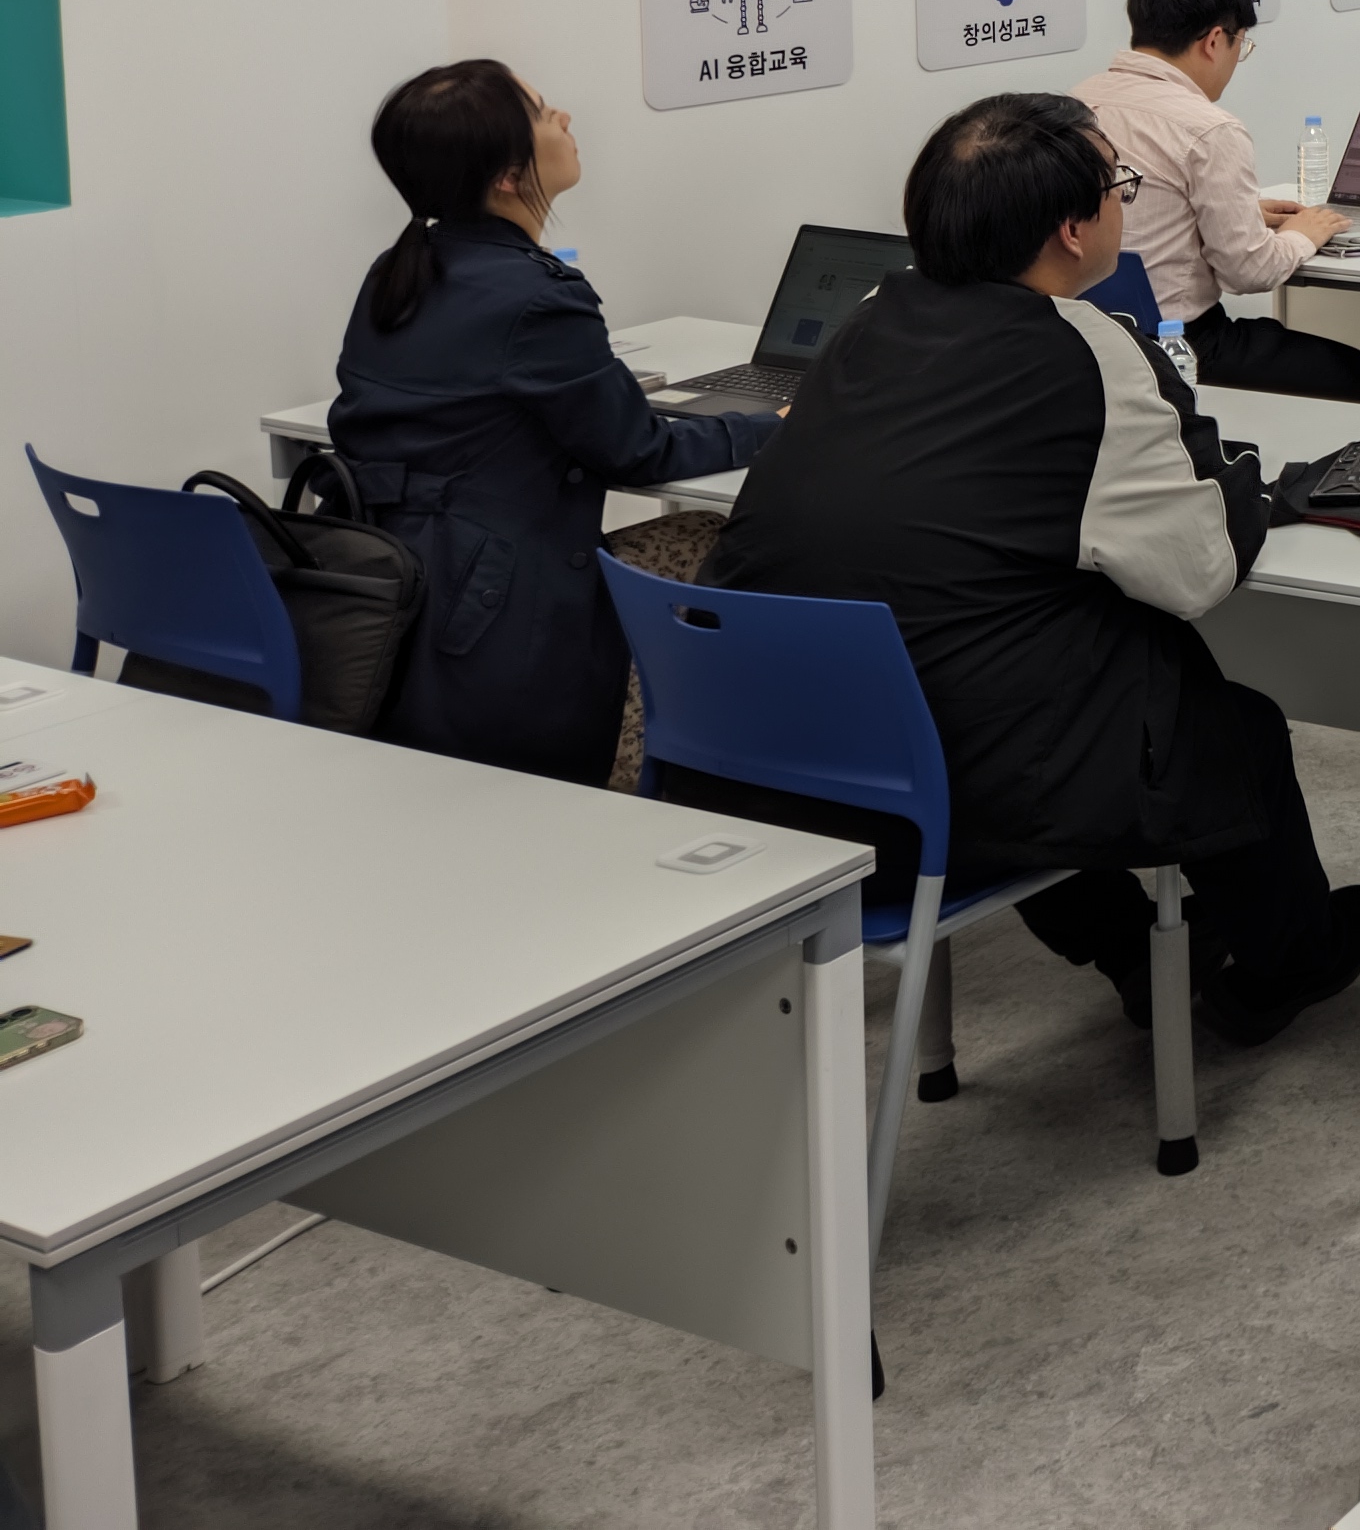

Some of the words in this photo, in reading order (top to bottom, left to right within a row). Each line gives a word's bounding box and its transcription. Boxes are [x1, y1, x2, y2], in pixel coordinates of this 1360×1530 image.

[962, 13, 1048, 48] 창의성교육
[699, 59, 718, 82] AI
[726, 46, 808, 79] 융합교육
